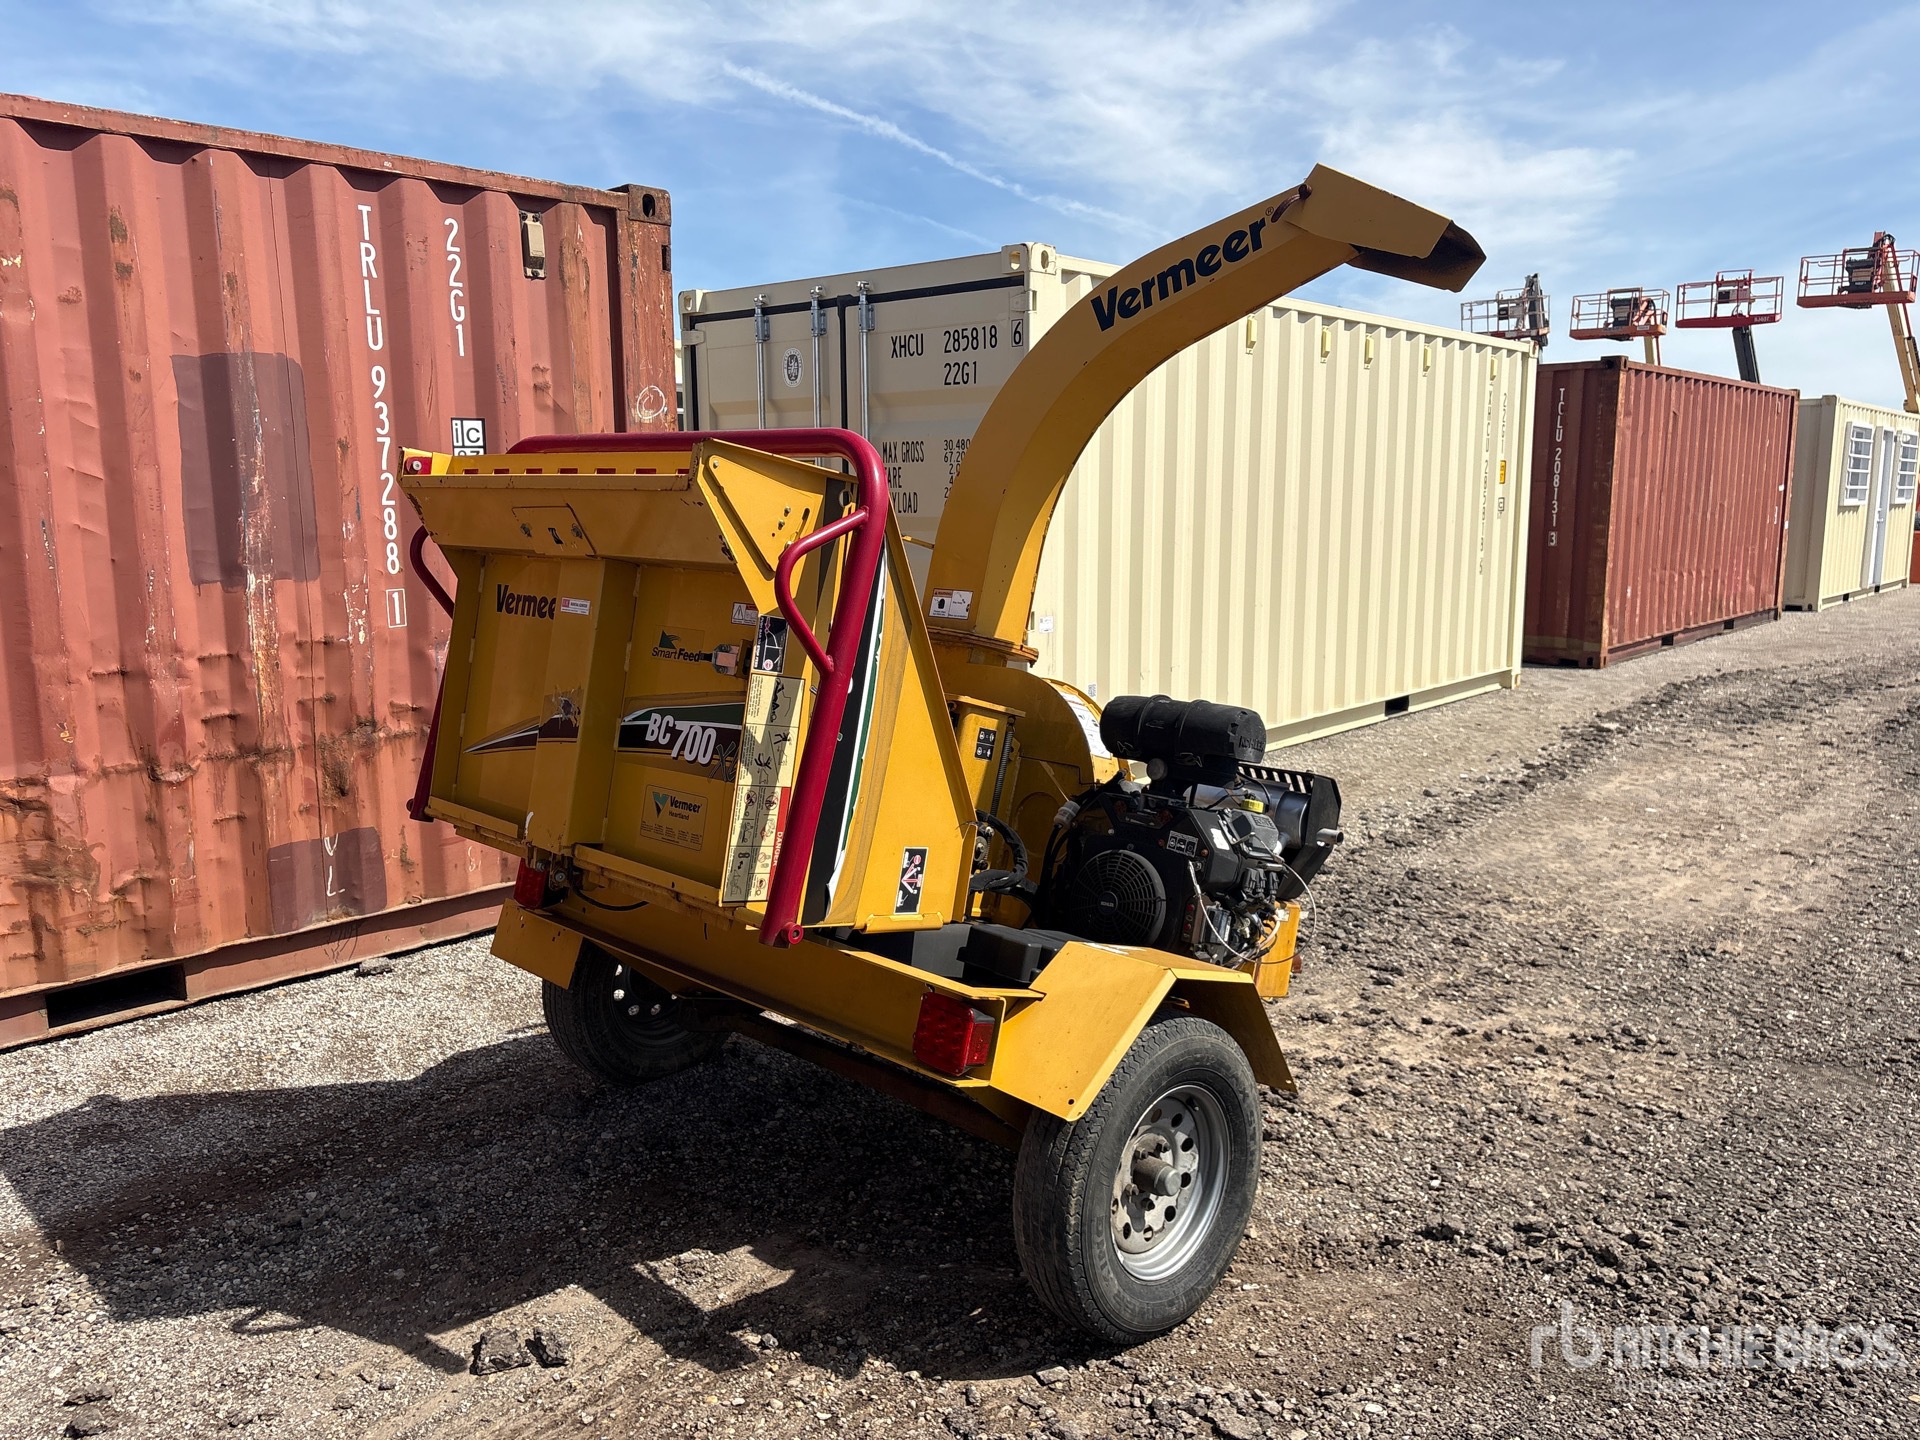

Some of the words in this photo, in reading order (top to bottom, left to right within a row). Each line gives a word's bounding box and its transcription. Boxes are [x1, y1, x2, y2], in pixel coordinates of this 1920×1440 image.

[444, 217, 465, 356] 22G1
[1091, 217, 1267, 332] Vermeer
[891, 333, 924, 359] XHCU
[943, 324, 998, 353] 285818
[1013, 321, 1022, 345] 6
[357, 204, 384, 351] TRLU
[371, 365, 400, 574] 937288
[943, 361, 977, 385] 22G1
[1555, 388, 1566, 442] TCLU
[882, 441, 898, 464] MAX
[901, 440, 925, 463] GROSS
[884, 466, 902, 488] ARE
[1551, 448, 1562, 527] 208131
[1550, 532, 1557, 546] 3
[669, 796, 701, 813] Vermeer
[773, 831, 784, 867] DANGER
